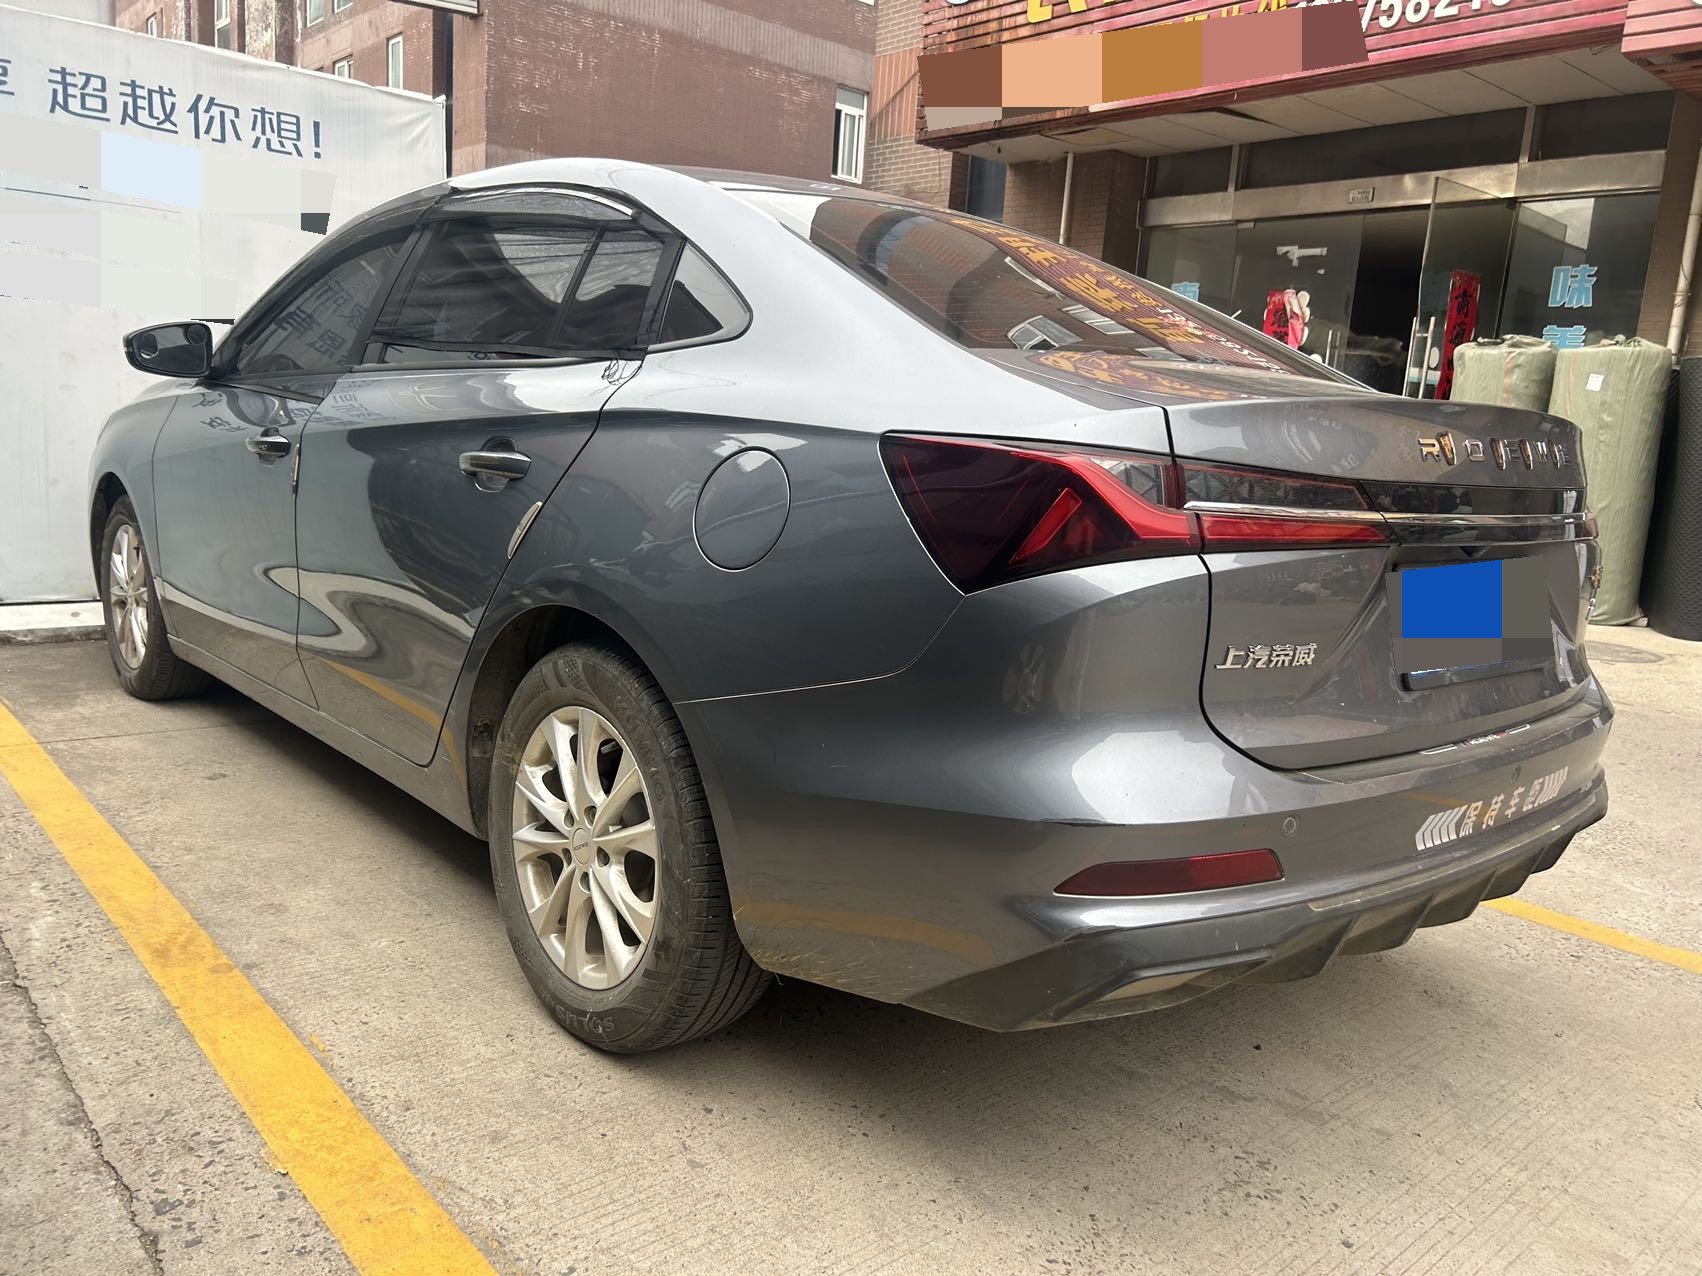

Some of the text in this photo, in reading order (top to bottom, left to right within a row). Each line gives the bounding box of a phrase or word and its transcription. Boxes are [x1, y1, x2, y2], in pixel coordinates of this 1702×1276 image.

[47, 66, 322, 159] 超越你想!
[1215, 642, 1317, 669] 上汽荣威
